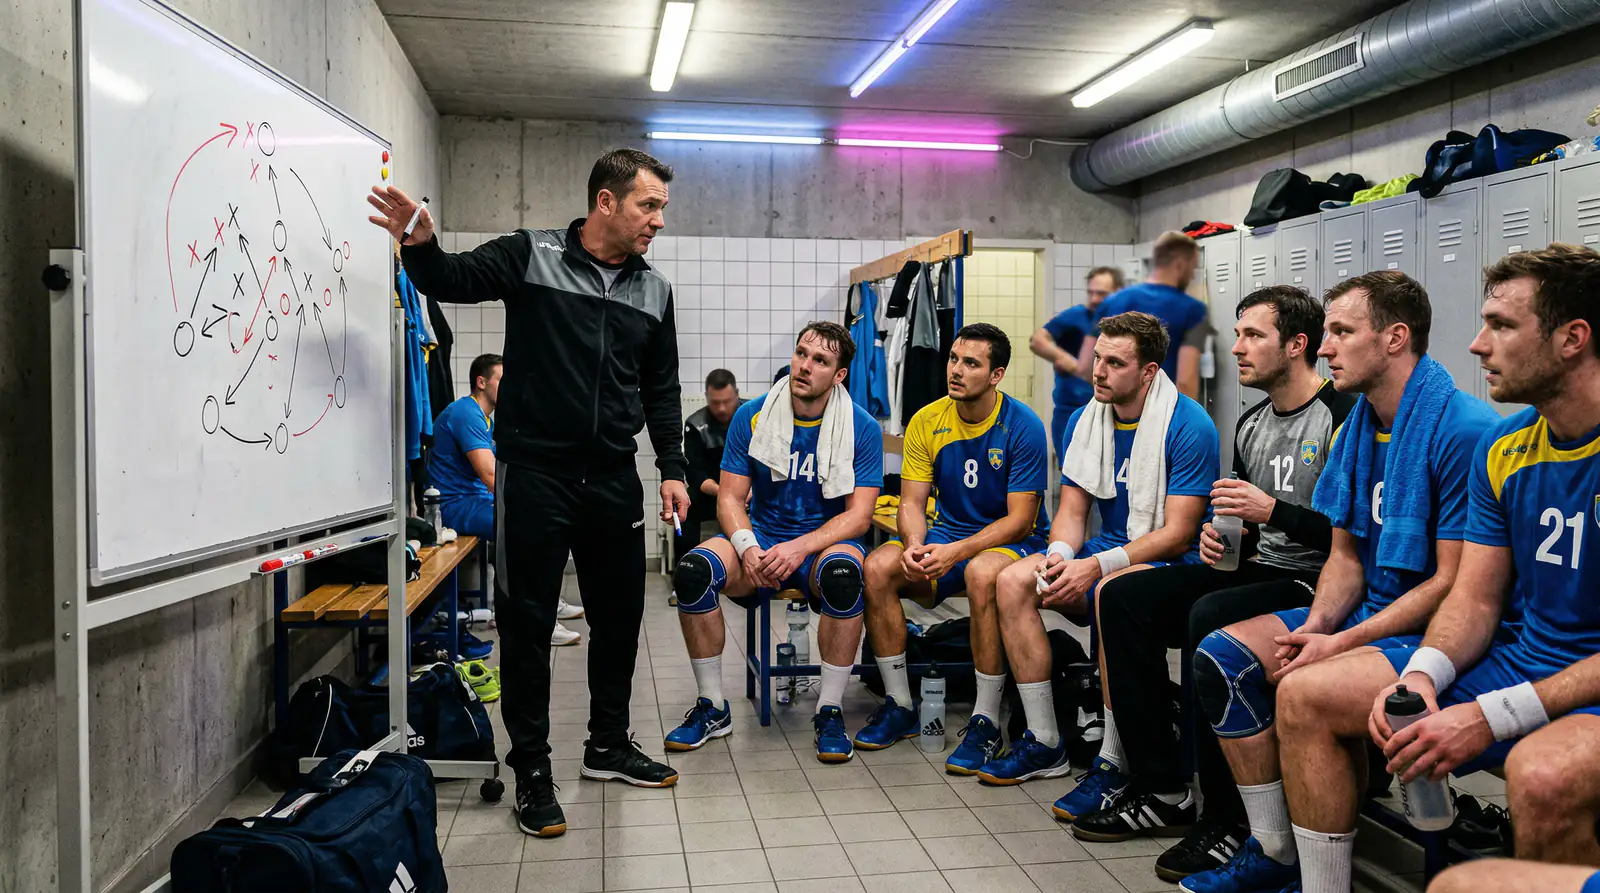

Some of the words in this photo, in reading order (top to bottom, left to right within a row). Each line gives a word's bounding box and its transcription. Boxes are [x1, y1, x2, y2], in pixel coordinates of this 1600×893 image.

[791, 452, 818, 486] 14
[963, 458, 979, 489] 8
[1116, 457, 1130, 490] 4
[1269, 455, 1294, 493] 12
[1535, 507, 1584, 570] 21
